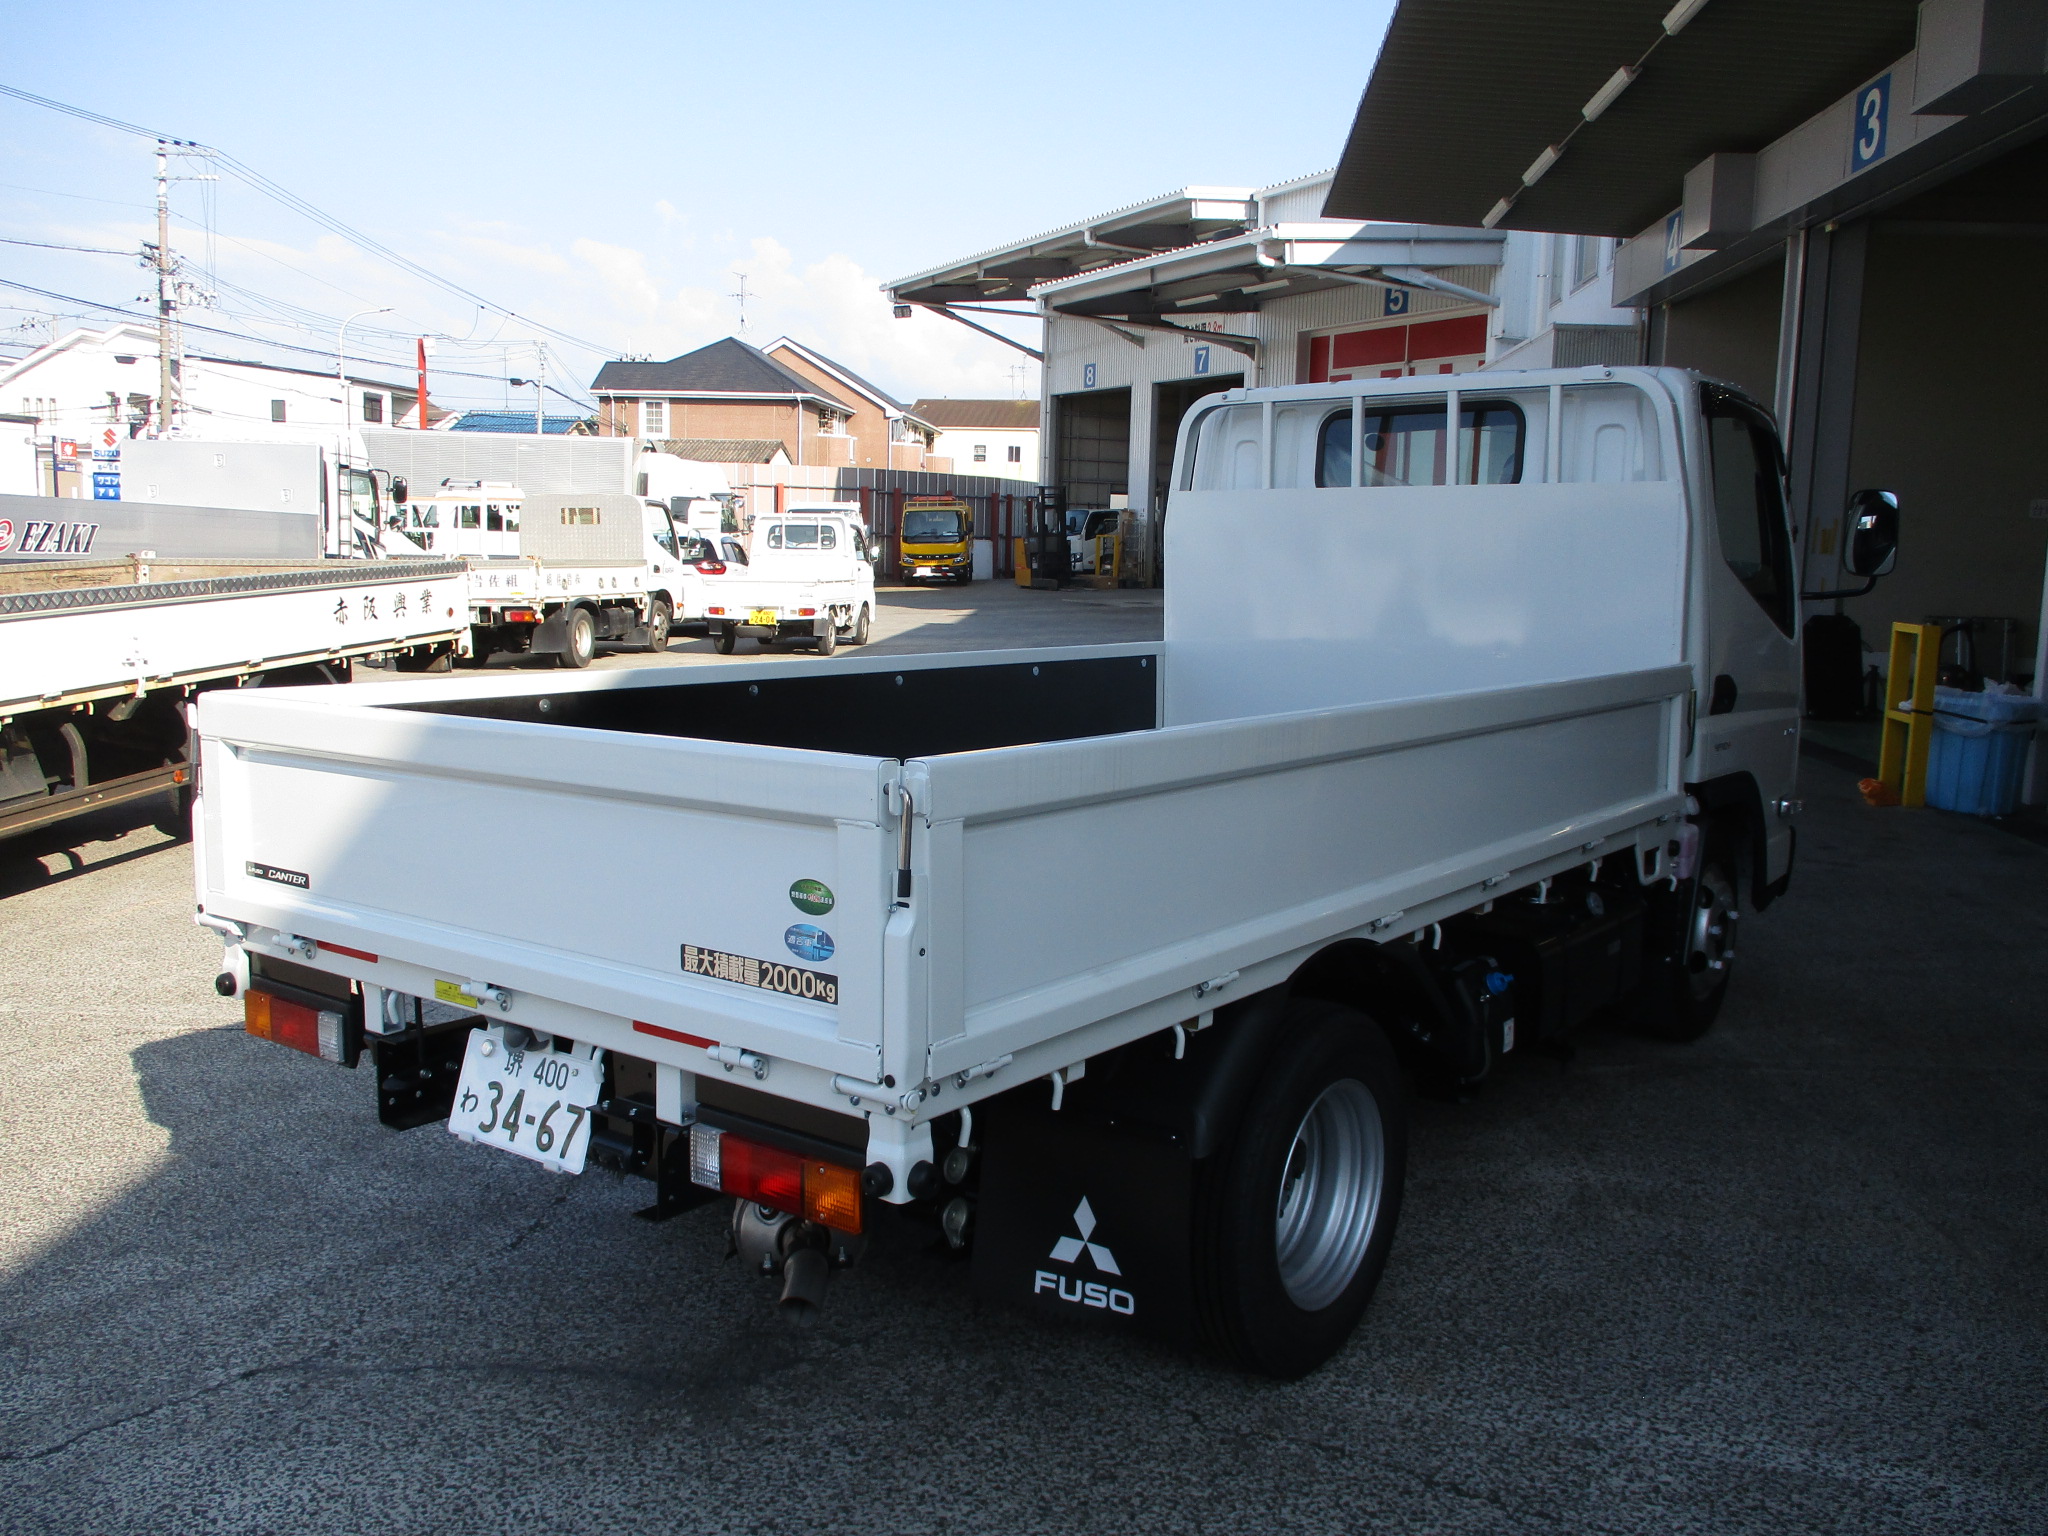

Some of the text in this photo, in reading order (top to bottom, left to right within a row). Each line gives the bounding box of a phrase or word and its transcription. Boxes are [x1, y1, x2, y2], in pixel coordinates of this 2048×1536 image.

[1858, 87, 1882, 161] 3
[1666, 216, 1681, 267] 4
[1389, 288, 1404, 312] 5
[1086, 366, 1094, 386] 8
[1197, 349, 1207, 372] 7
[17, 520, 99, 553] EZAKI
[268, 870, 306, 885] CANTER
[504, 1052, 570, 1091] 堺 400
[460, 1080, 587, 1160] わ 34-67
[1034, 1269, 1135, 1315] FUSO
